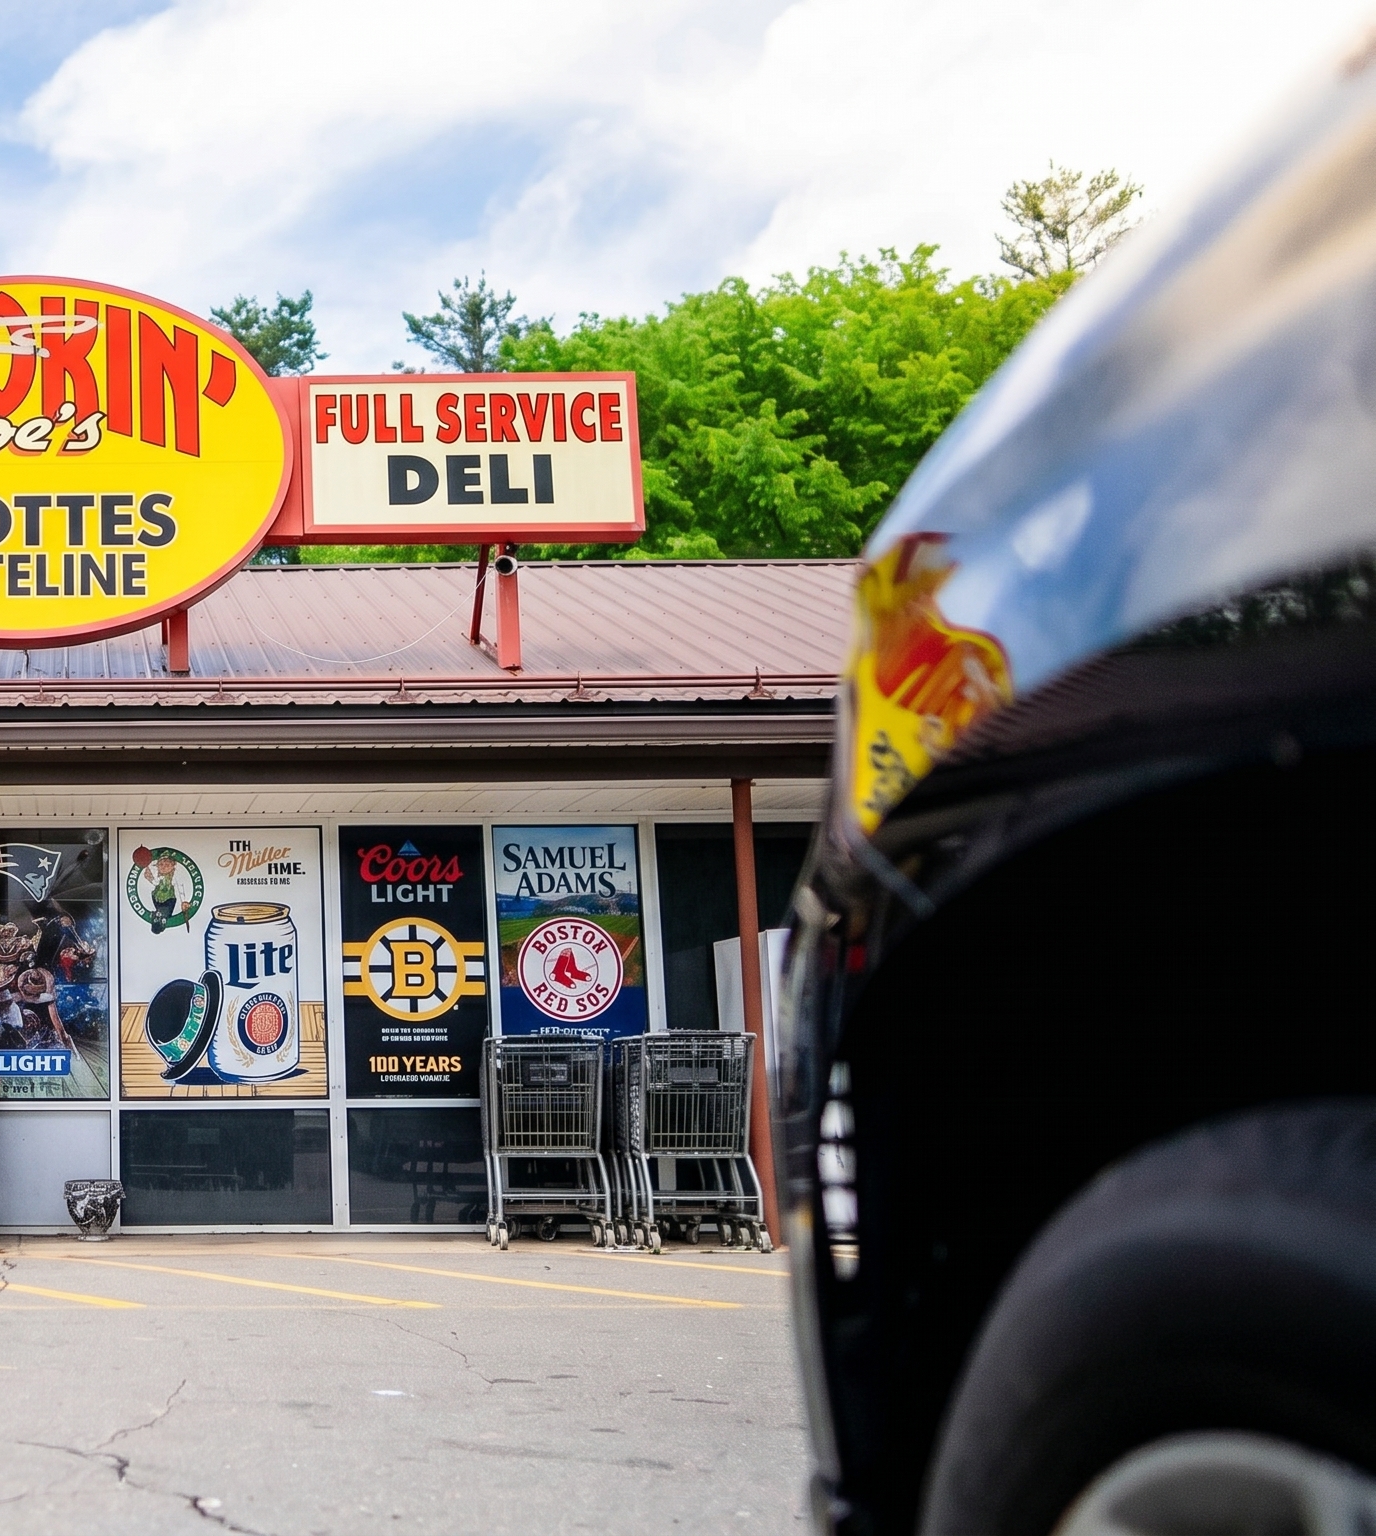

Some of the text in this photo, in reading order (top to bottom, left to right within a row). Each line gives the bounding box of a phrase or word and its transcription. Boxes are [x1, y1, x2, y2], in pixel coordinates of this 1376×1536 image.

[315, 392, 623, 444] FULL SERVICE
[387, 454, 555, 505] DELI
[358, 845, 464, 883] Coors
[503, 843, 626, 873] SAMUEL
[371, 884, 453, 902] LIGHT
[516, 871, 616, 899] ADAMS
[532, 925, 608, 955] BOSTON
[224, 942, 293, 989] Lite
[390, 941, 435, 997] B
[533, 982, 568, 1013] RED
[402, 1056, 462, 1073] YEARS
